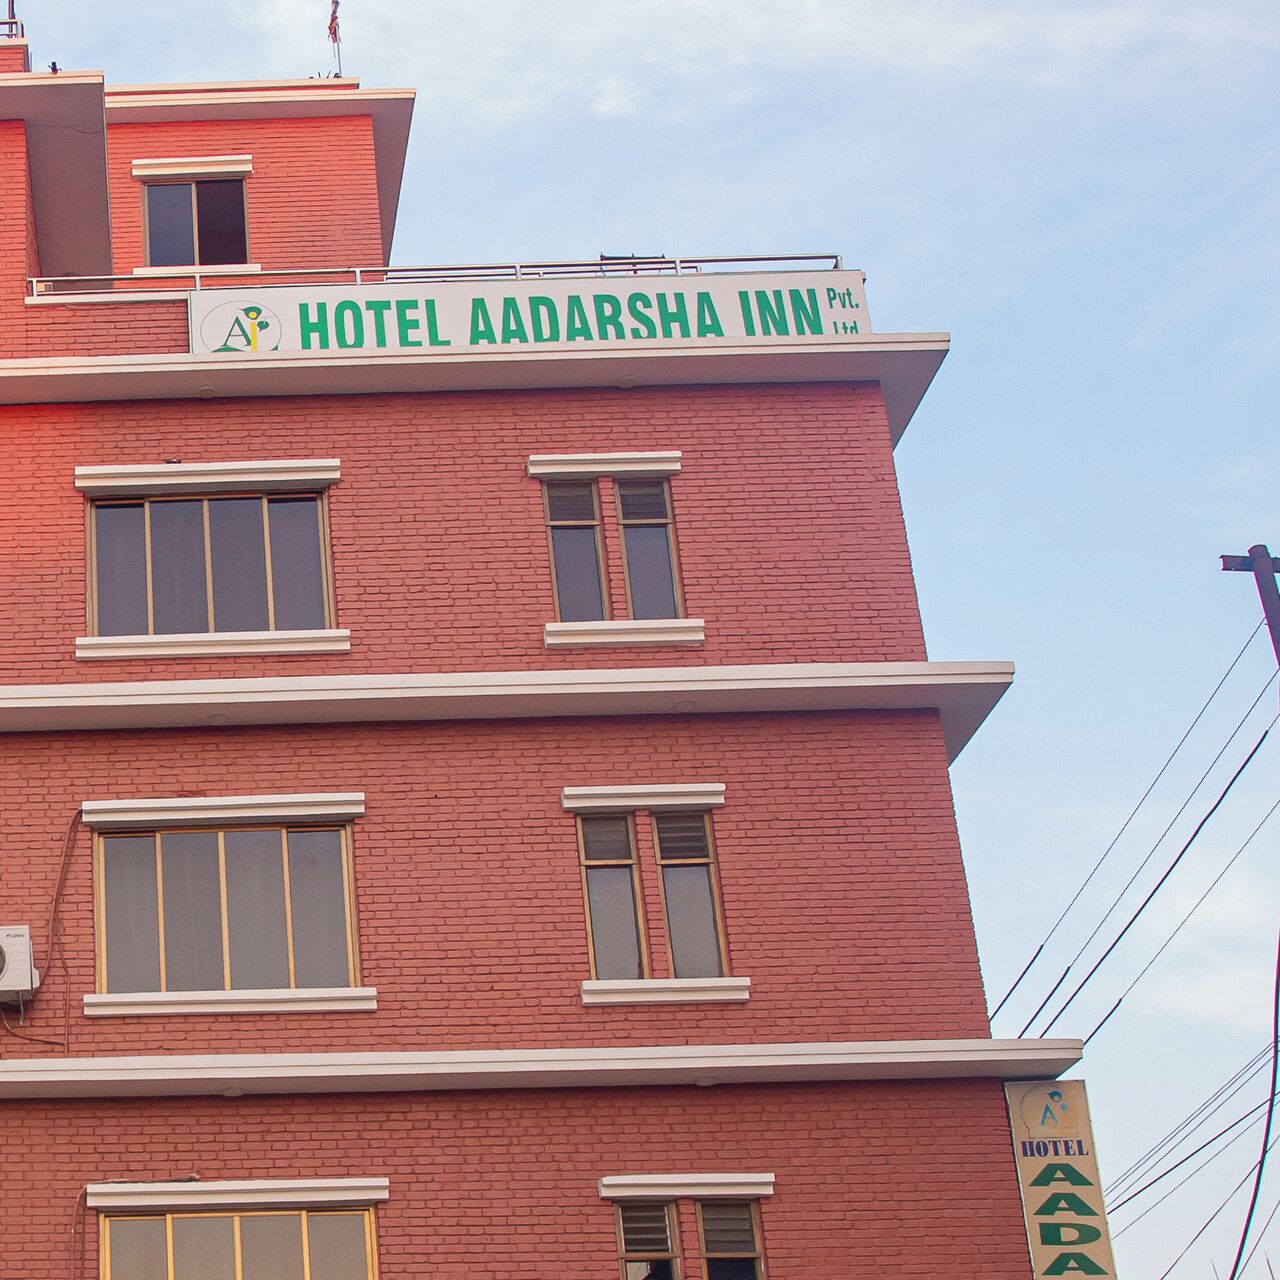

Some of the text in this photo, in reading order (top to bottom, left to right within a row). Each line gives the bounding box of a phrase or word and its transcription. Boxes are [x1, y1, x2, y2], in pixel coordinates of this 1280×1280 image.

[298, 287, 859, 350] HOTEL AADARSHA INN Pvt.
[1021, 1139, 1089, 1158] HOTEL
